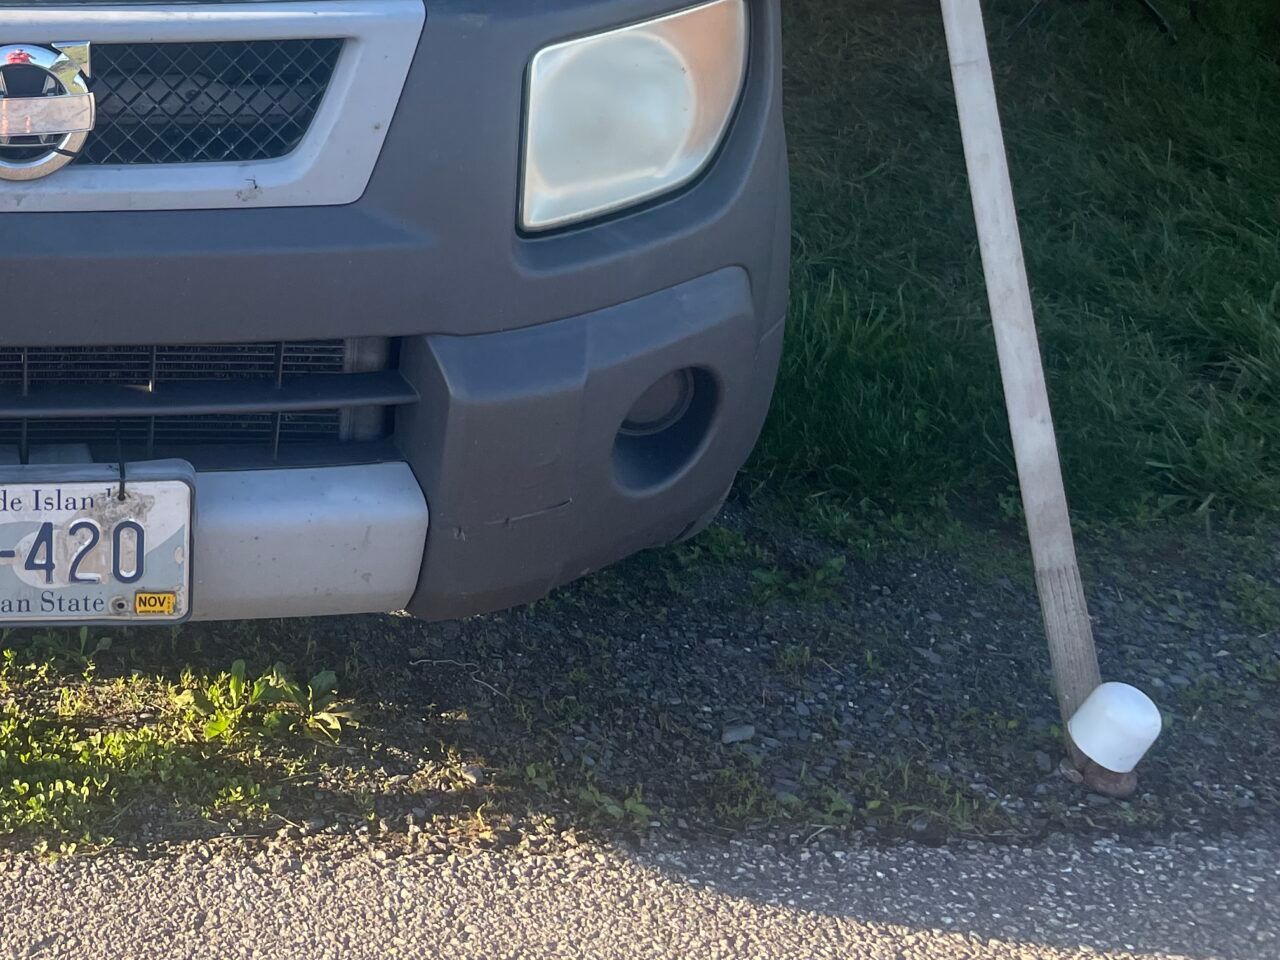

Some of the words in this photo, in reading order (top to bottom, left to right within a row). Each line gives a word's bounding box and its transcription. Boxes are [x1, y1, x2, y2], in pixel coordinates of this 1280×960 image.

[31, 487, 112, 512] Islan
[39, 590, 105, 613] State
[138, 595, 167, 608] NOV
